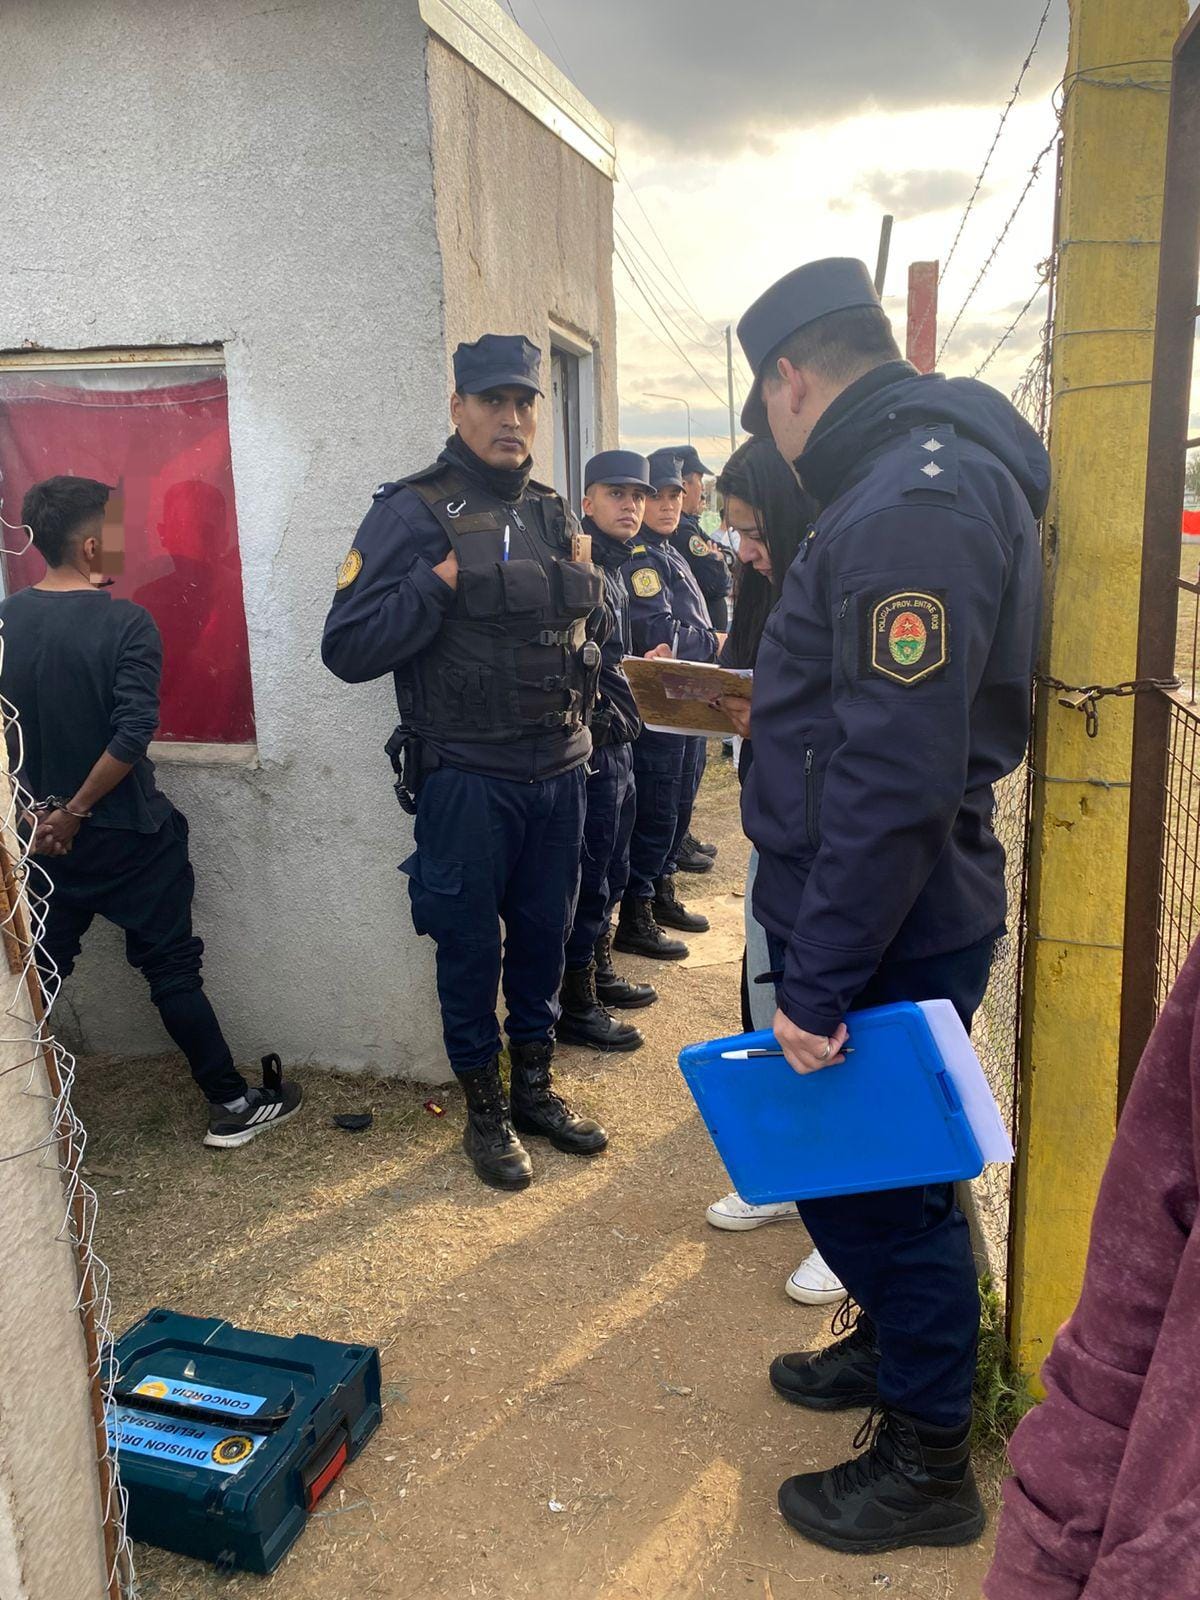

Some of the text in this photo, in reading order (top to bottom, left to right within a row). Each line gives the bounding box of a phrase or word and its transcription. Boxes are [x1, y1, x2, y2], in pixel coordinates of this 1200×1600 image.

[914, 600, 936, 614] ENTRE
[931, 614, 939, 630] RIOS
[171, 1387, 251, 1410] CONCORDIA
[119, 1414, 206, 1439] PELIGROSAS
[107, 1430, 144, 1447] DROG
[143, 1439, 208, 1461] DIVISION
